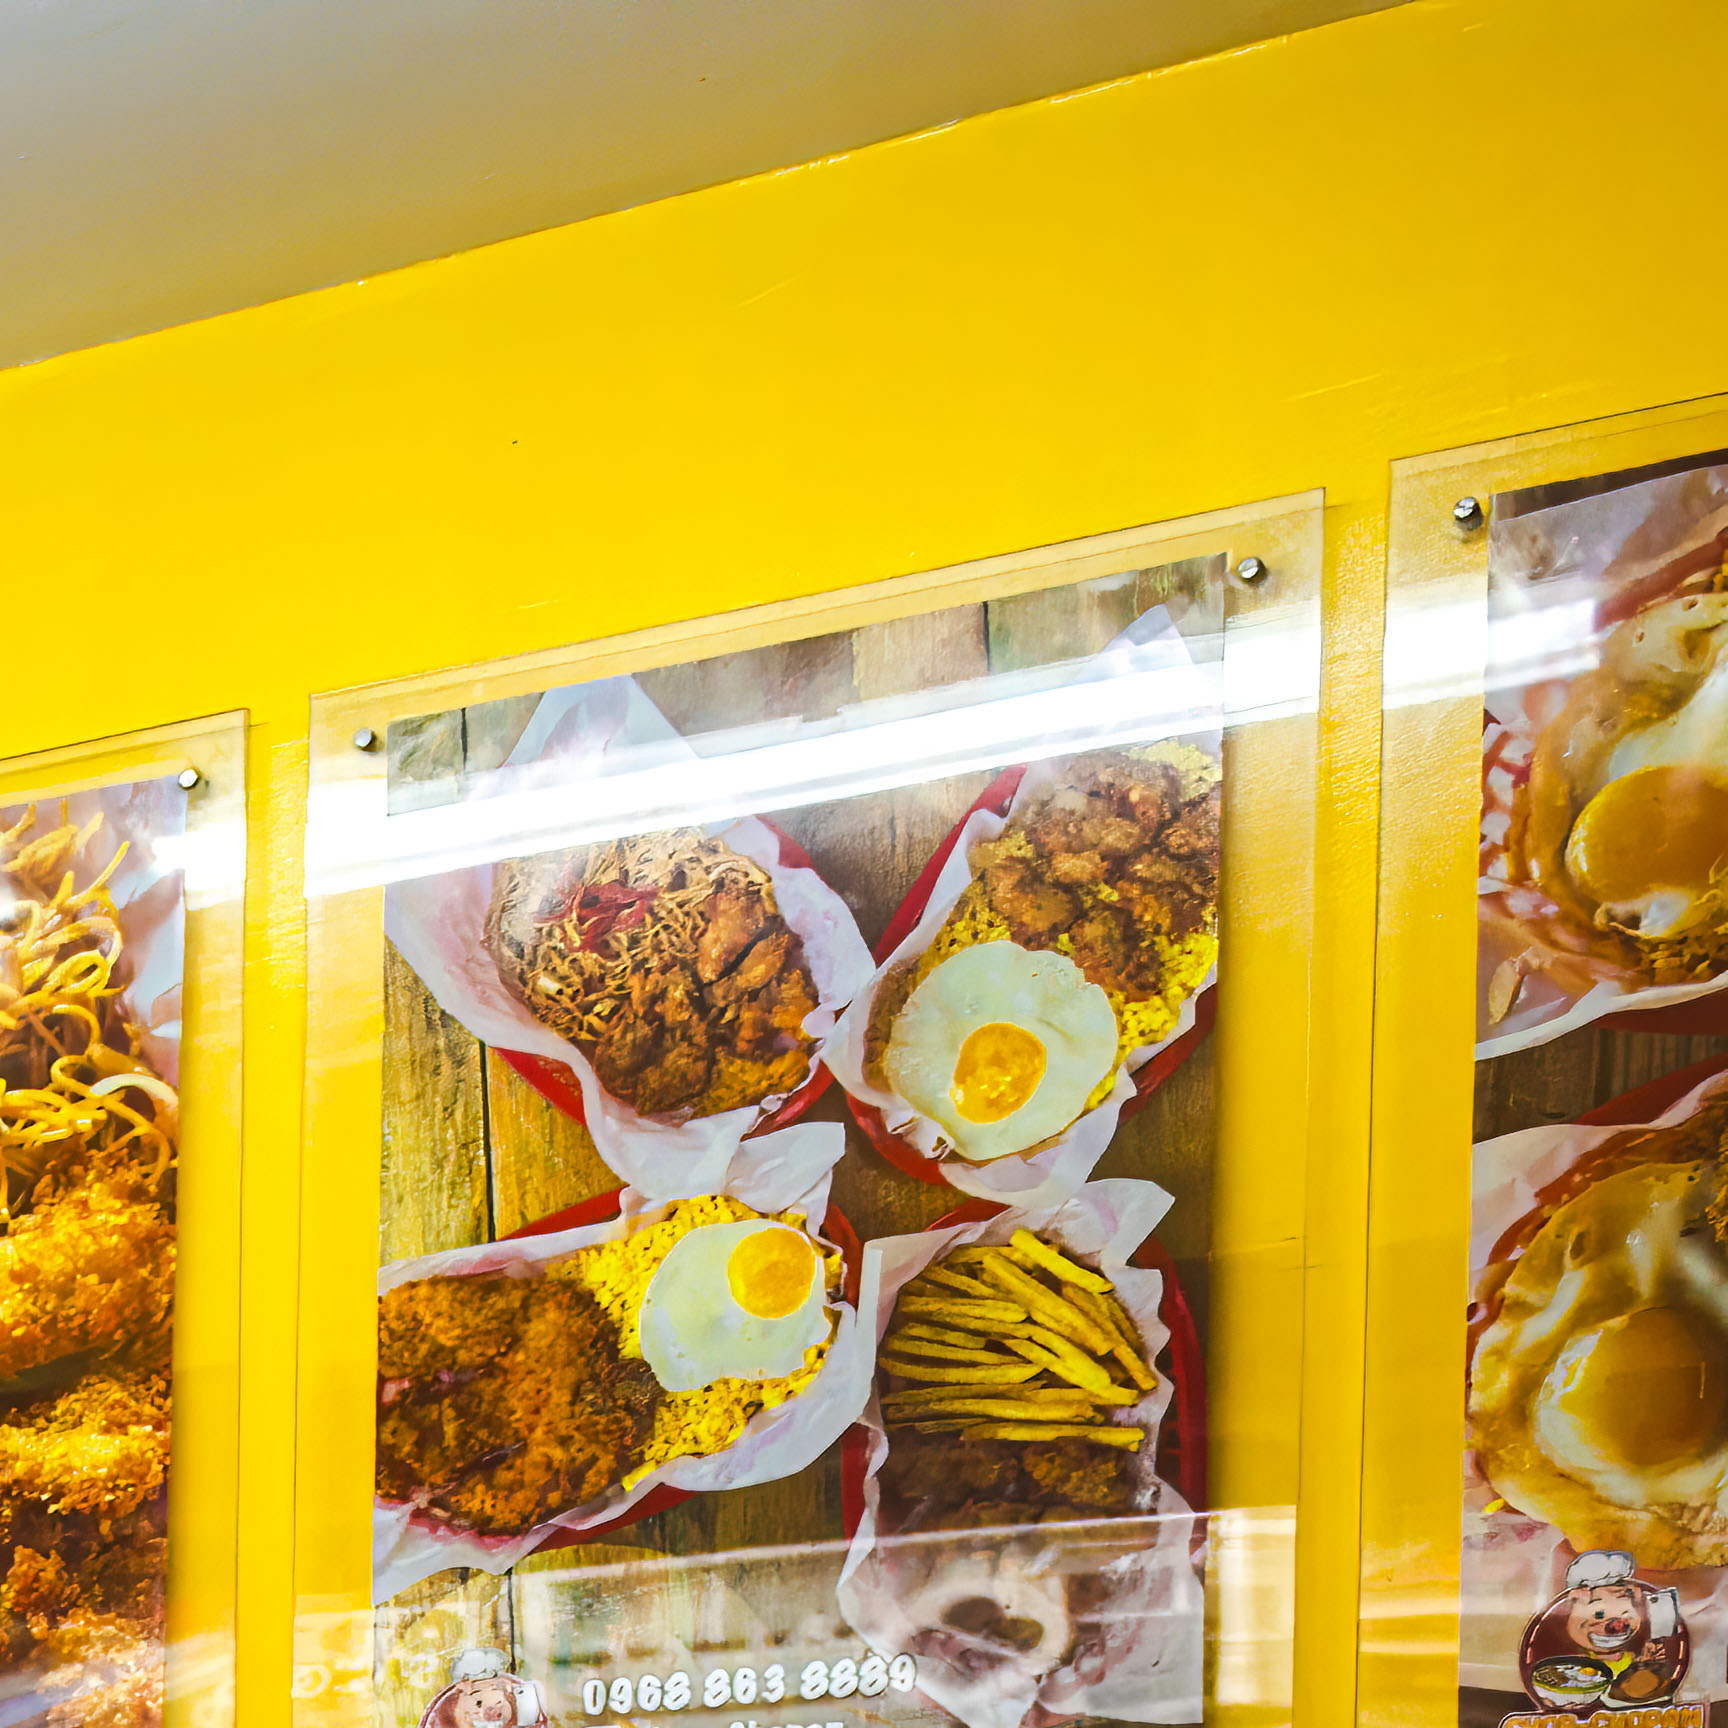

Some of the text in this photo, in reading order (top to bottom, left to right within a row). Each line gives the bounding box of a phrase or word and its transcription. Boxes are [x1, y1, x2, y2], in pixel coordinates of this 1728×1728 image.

[582, 1653, 917, 1716] 0968 863 8889
